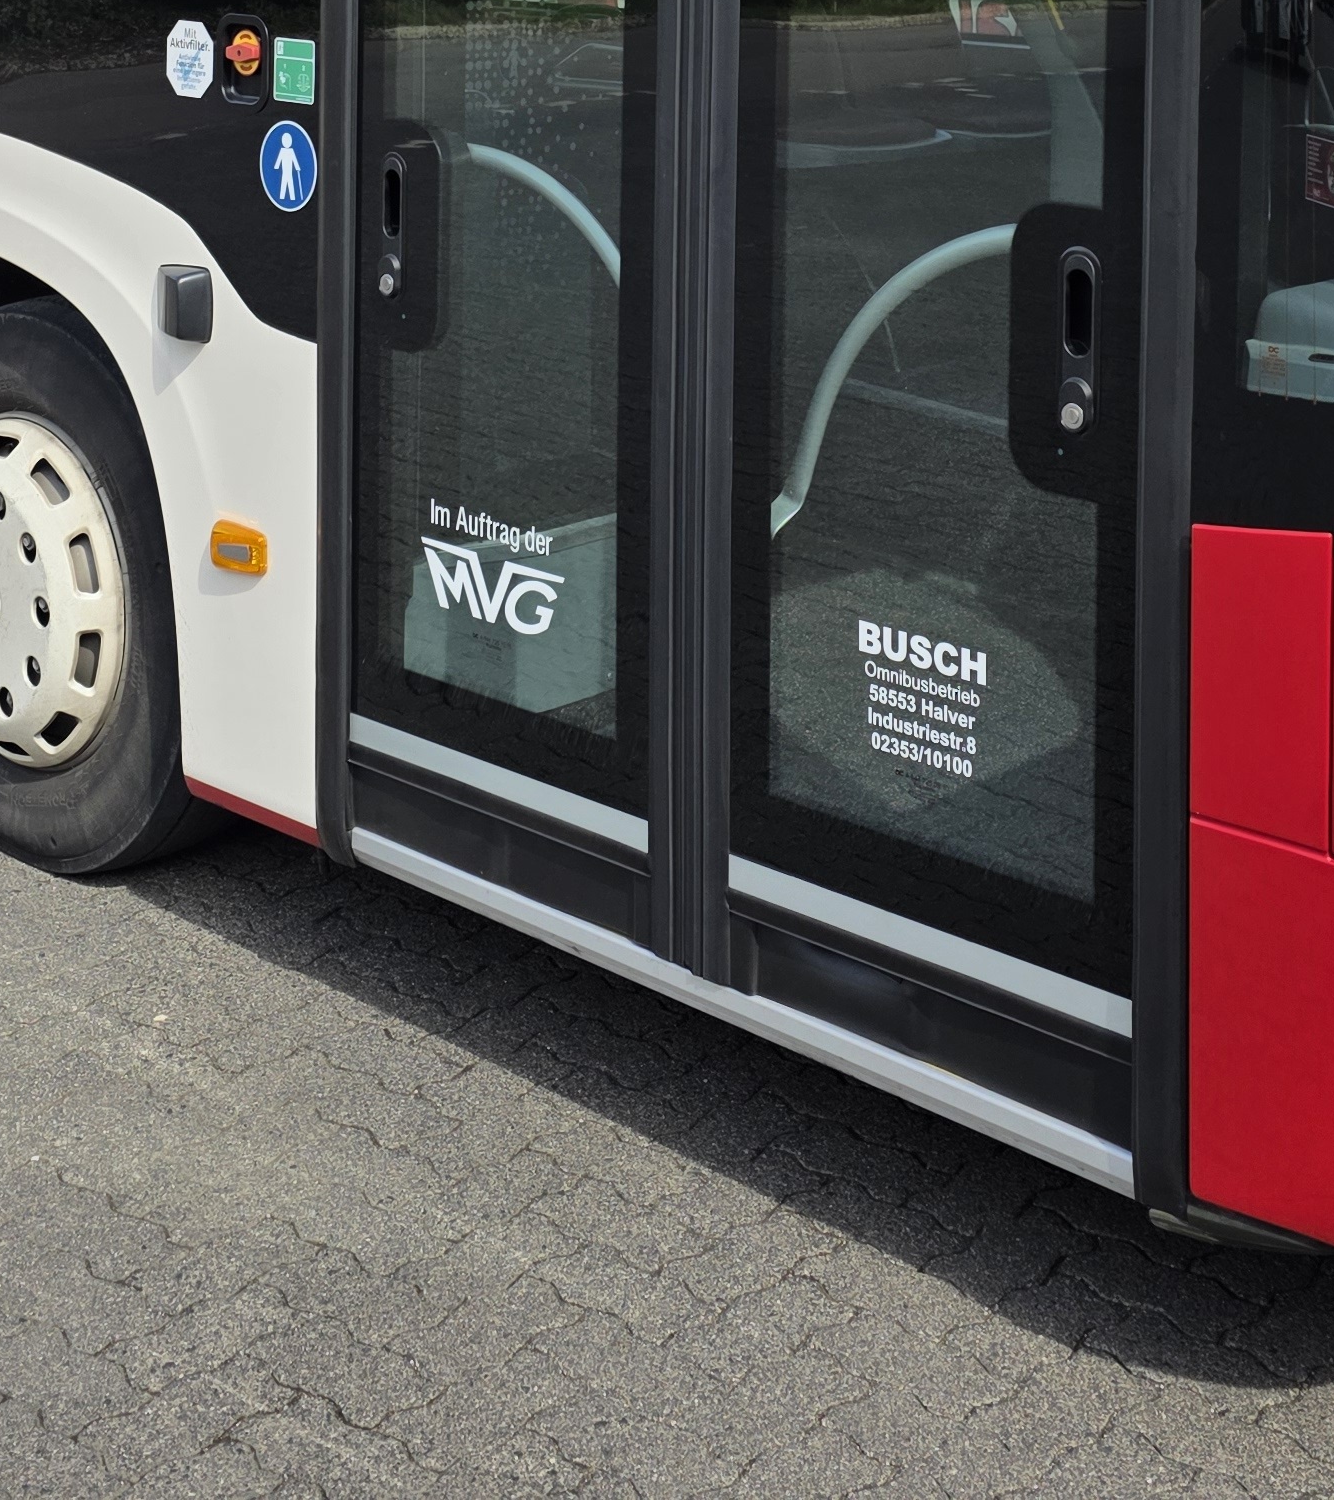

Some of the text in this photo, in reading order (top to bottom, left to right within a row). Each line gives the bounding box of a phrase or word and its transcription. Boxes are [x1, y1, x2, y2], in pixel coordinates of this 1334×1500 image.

[170, 37, 210, 52] Aktivfilter.
[184, 28, 197, 39] Mit
[430, 498, 554, 556] Im Auftrag der
[421, 536, 565, 635] MVG
[858, 619, 986, 686] BUSCH
[864, 660, 980, 707] Omnibusbetrieb
[869, 683, 976, 730] 58553 Halver
[871, 732, 973, 778] 02353/10100
